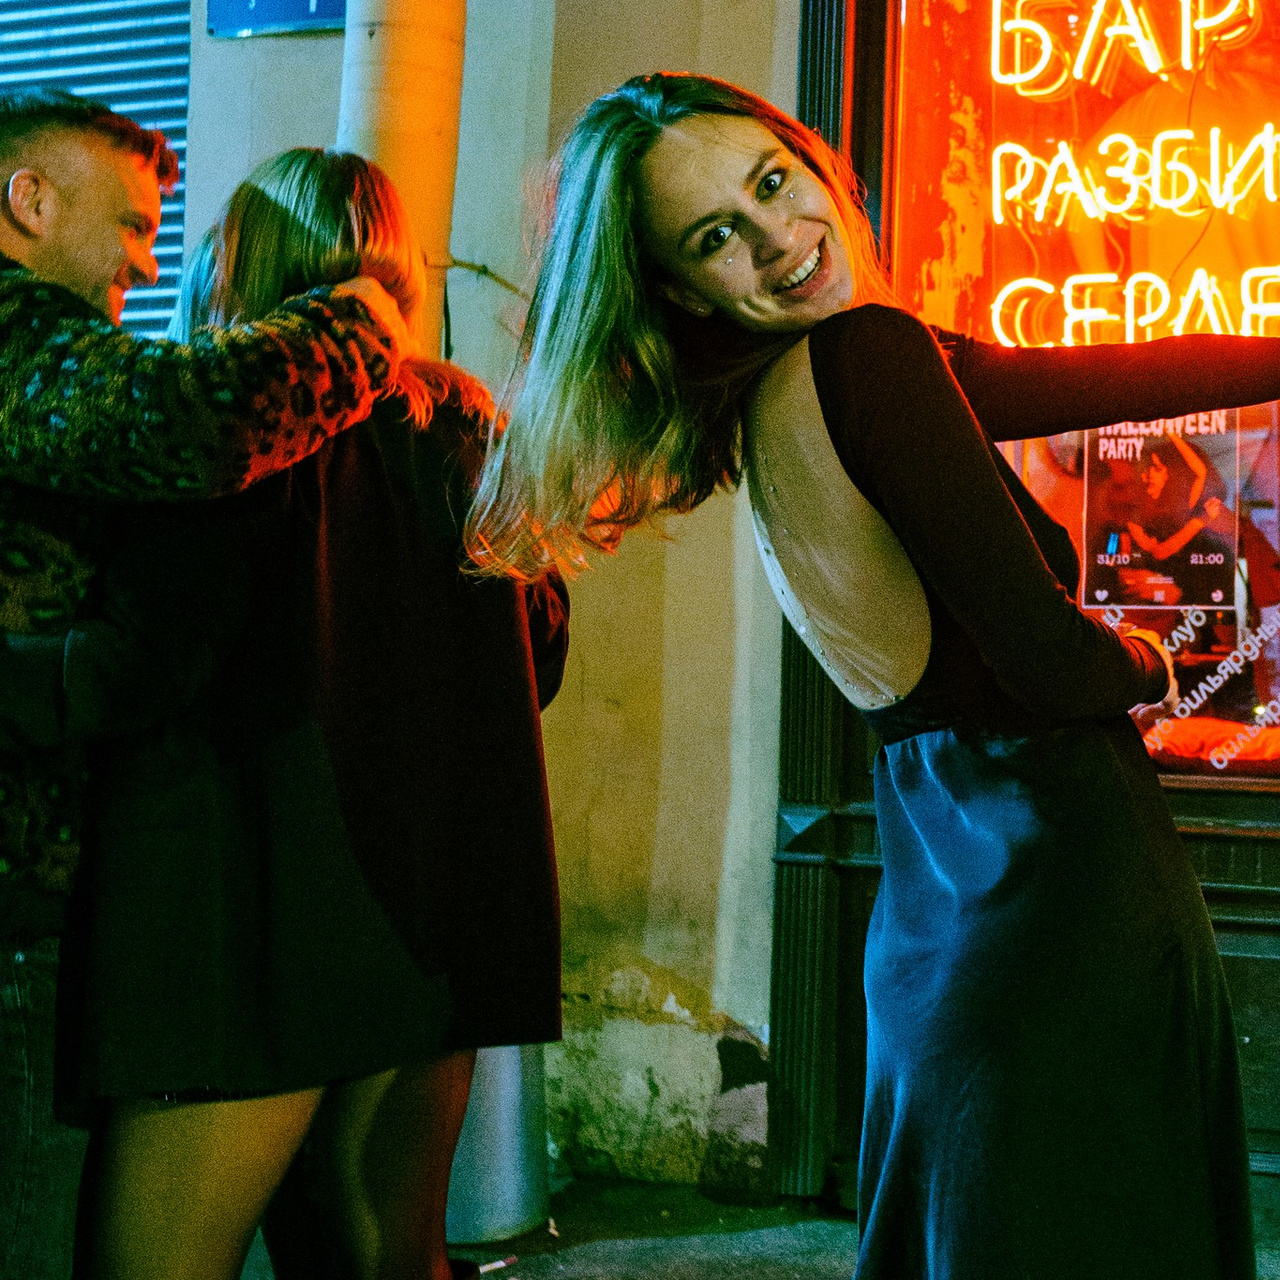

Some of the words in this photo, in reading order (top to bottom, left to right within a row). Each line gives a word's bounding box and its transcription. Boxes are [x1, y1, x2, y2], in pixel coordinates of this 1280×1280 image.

[1099, 437, 1145, 461] PARTY
[1097, 553, 1131, 566] 31/10
[1190, 553, 1225, 565] 21:00
